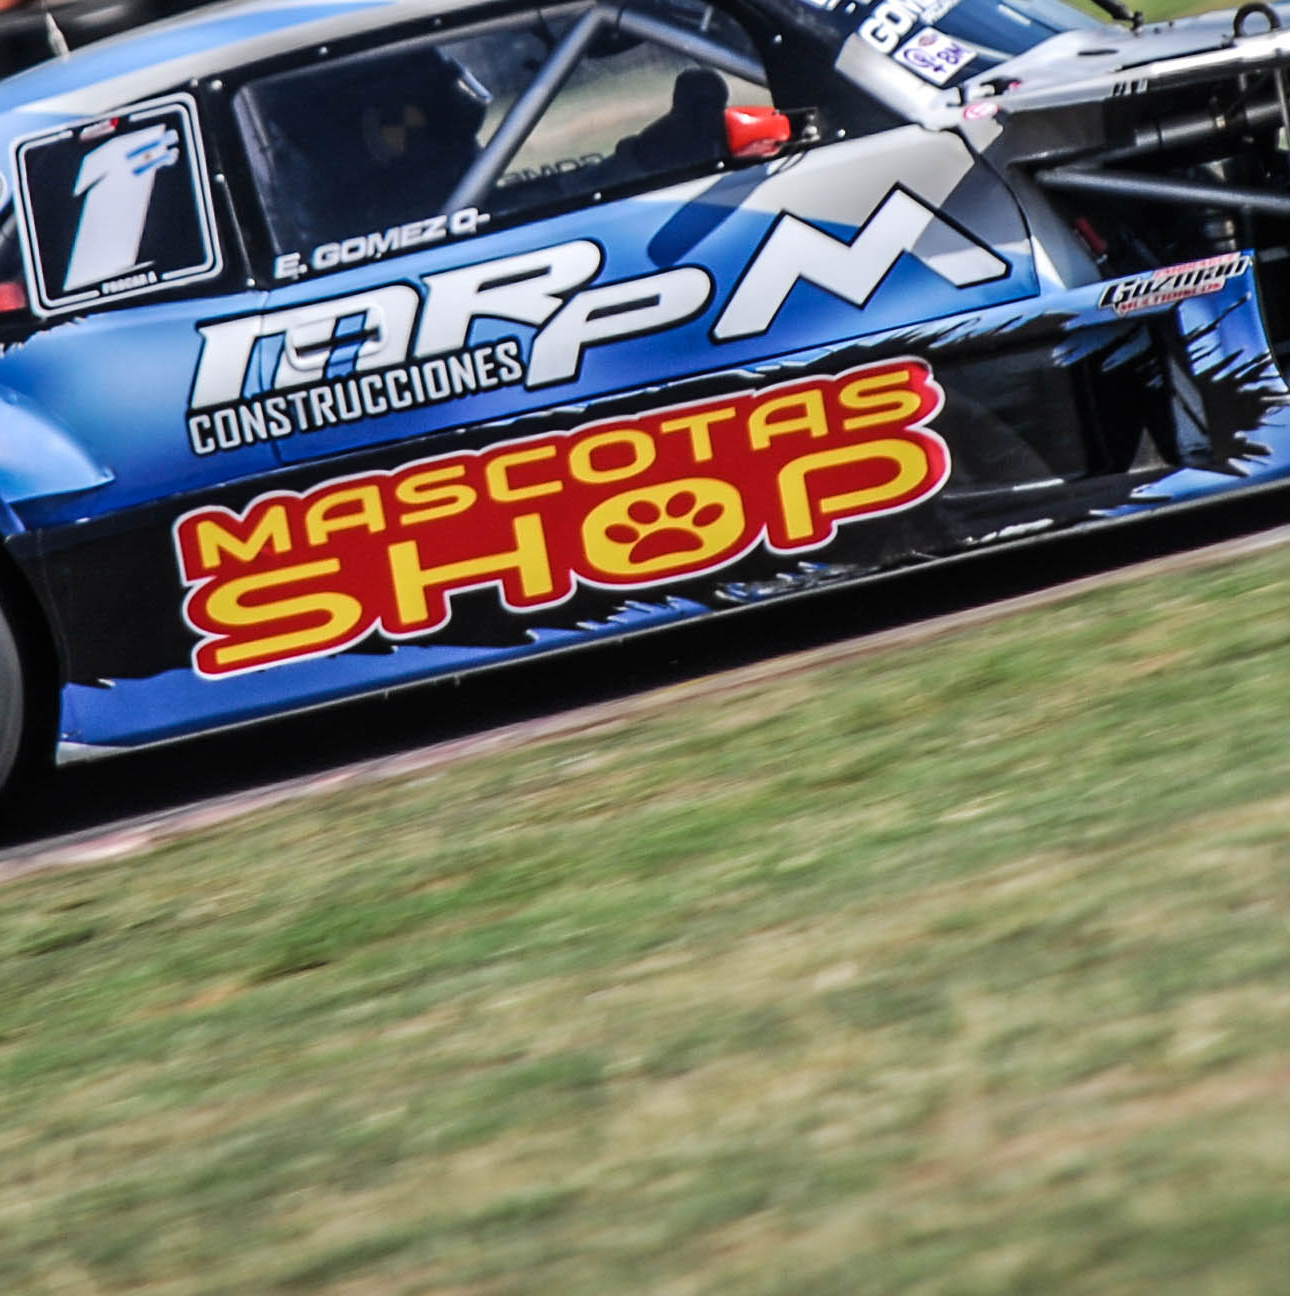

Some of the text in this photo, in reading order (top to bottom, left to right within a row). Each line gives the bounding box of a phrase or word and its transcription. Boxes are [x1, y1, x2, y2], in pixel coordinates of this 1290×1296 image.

[63, 124, 165, 292] 1
[312, 215, 447, 271] GOMEZ
[189, 340, 523, 455] CONSTRUCCIONES
[196, 369, 922, 569] MASCOTAS
[203, 438, 929, 666] SHOP
